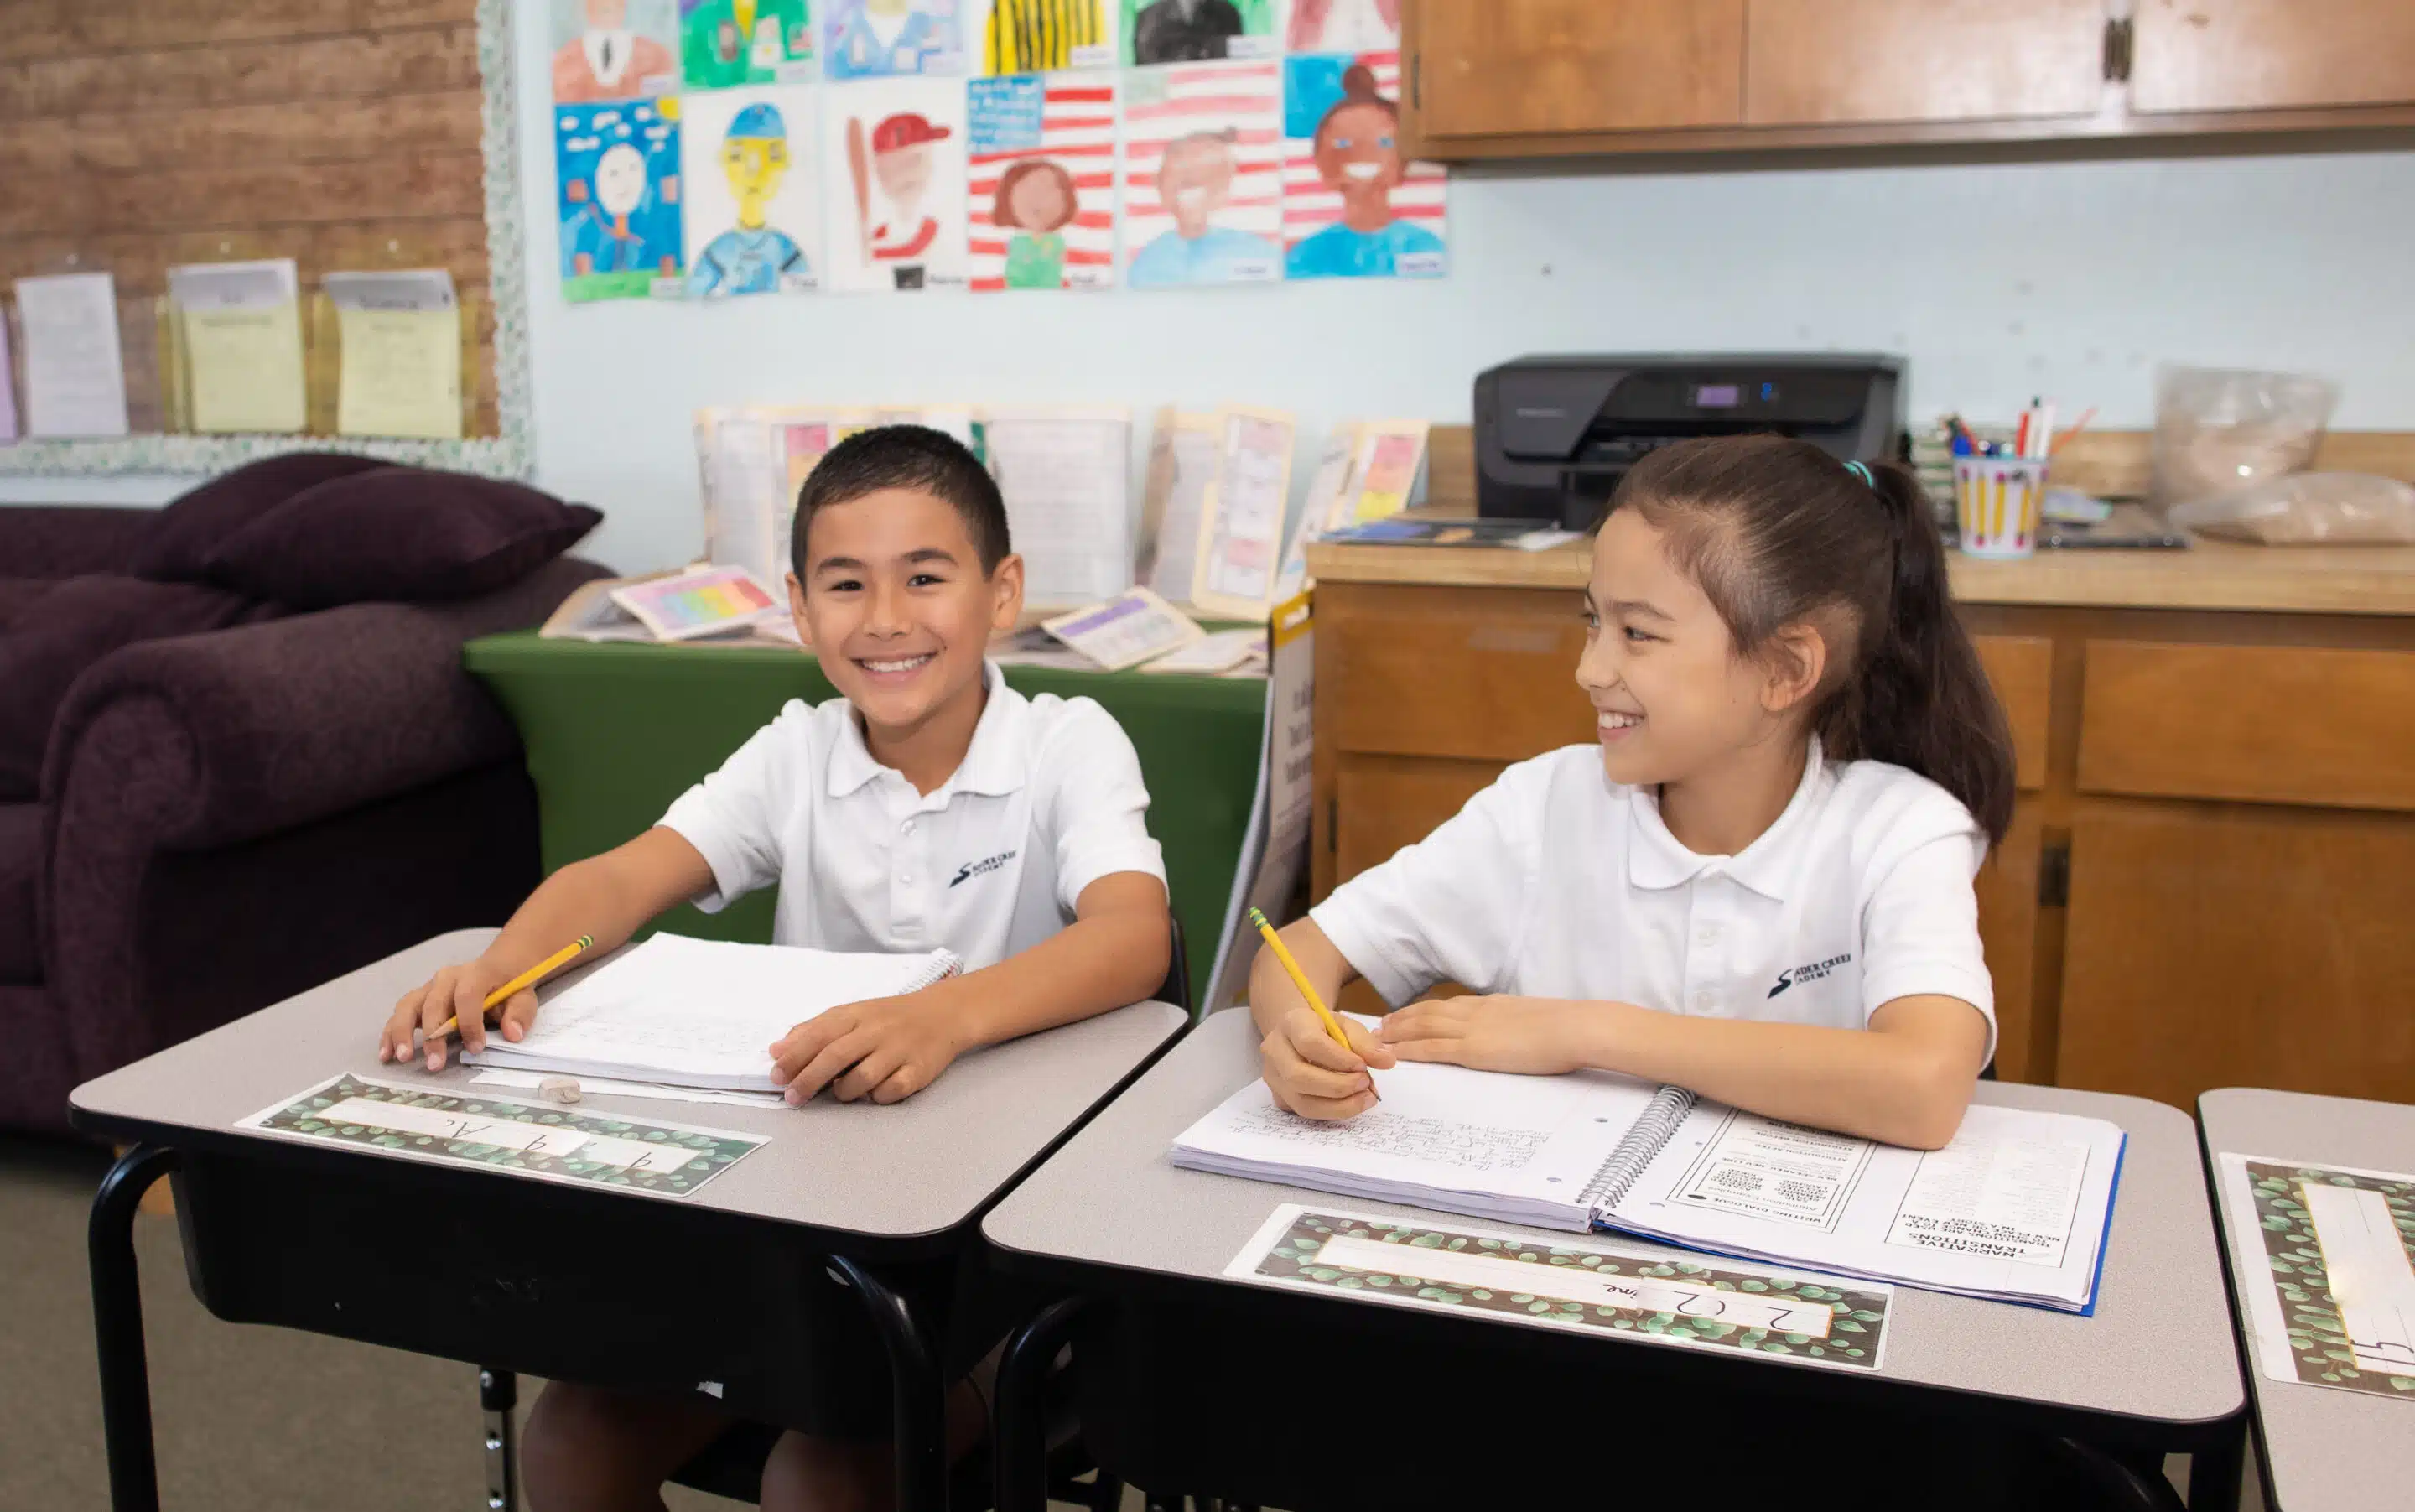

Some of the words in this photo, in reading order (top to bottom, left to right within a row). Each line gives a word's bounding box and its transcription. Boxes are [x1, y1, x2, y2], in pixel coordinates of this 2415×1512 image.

[1711, 1197, 1768, 1212] DIALOGUE
[1771, 1210, 1820, 1223] WRITING
[1901, 1213, 1938, 1223] EVENT
[1903, 1222, 1935, 1230] USED
[1907, 1232, 2026, 1254] TRANSITIONS
[1968, 1232, 2050, 1247] TRANSITIONS
[1915, 1239, 2014, 1257] NARRATIVE
[1767, 1307, 1794, 1332] 2
